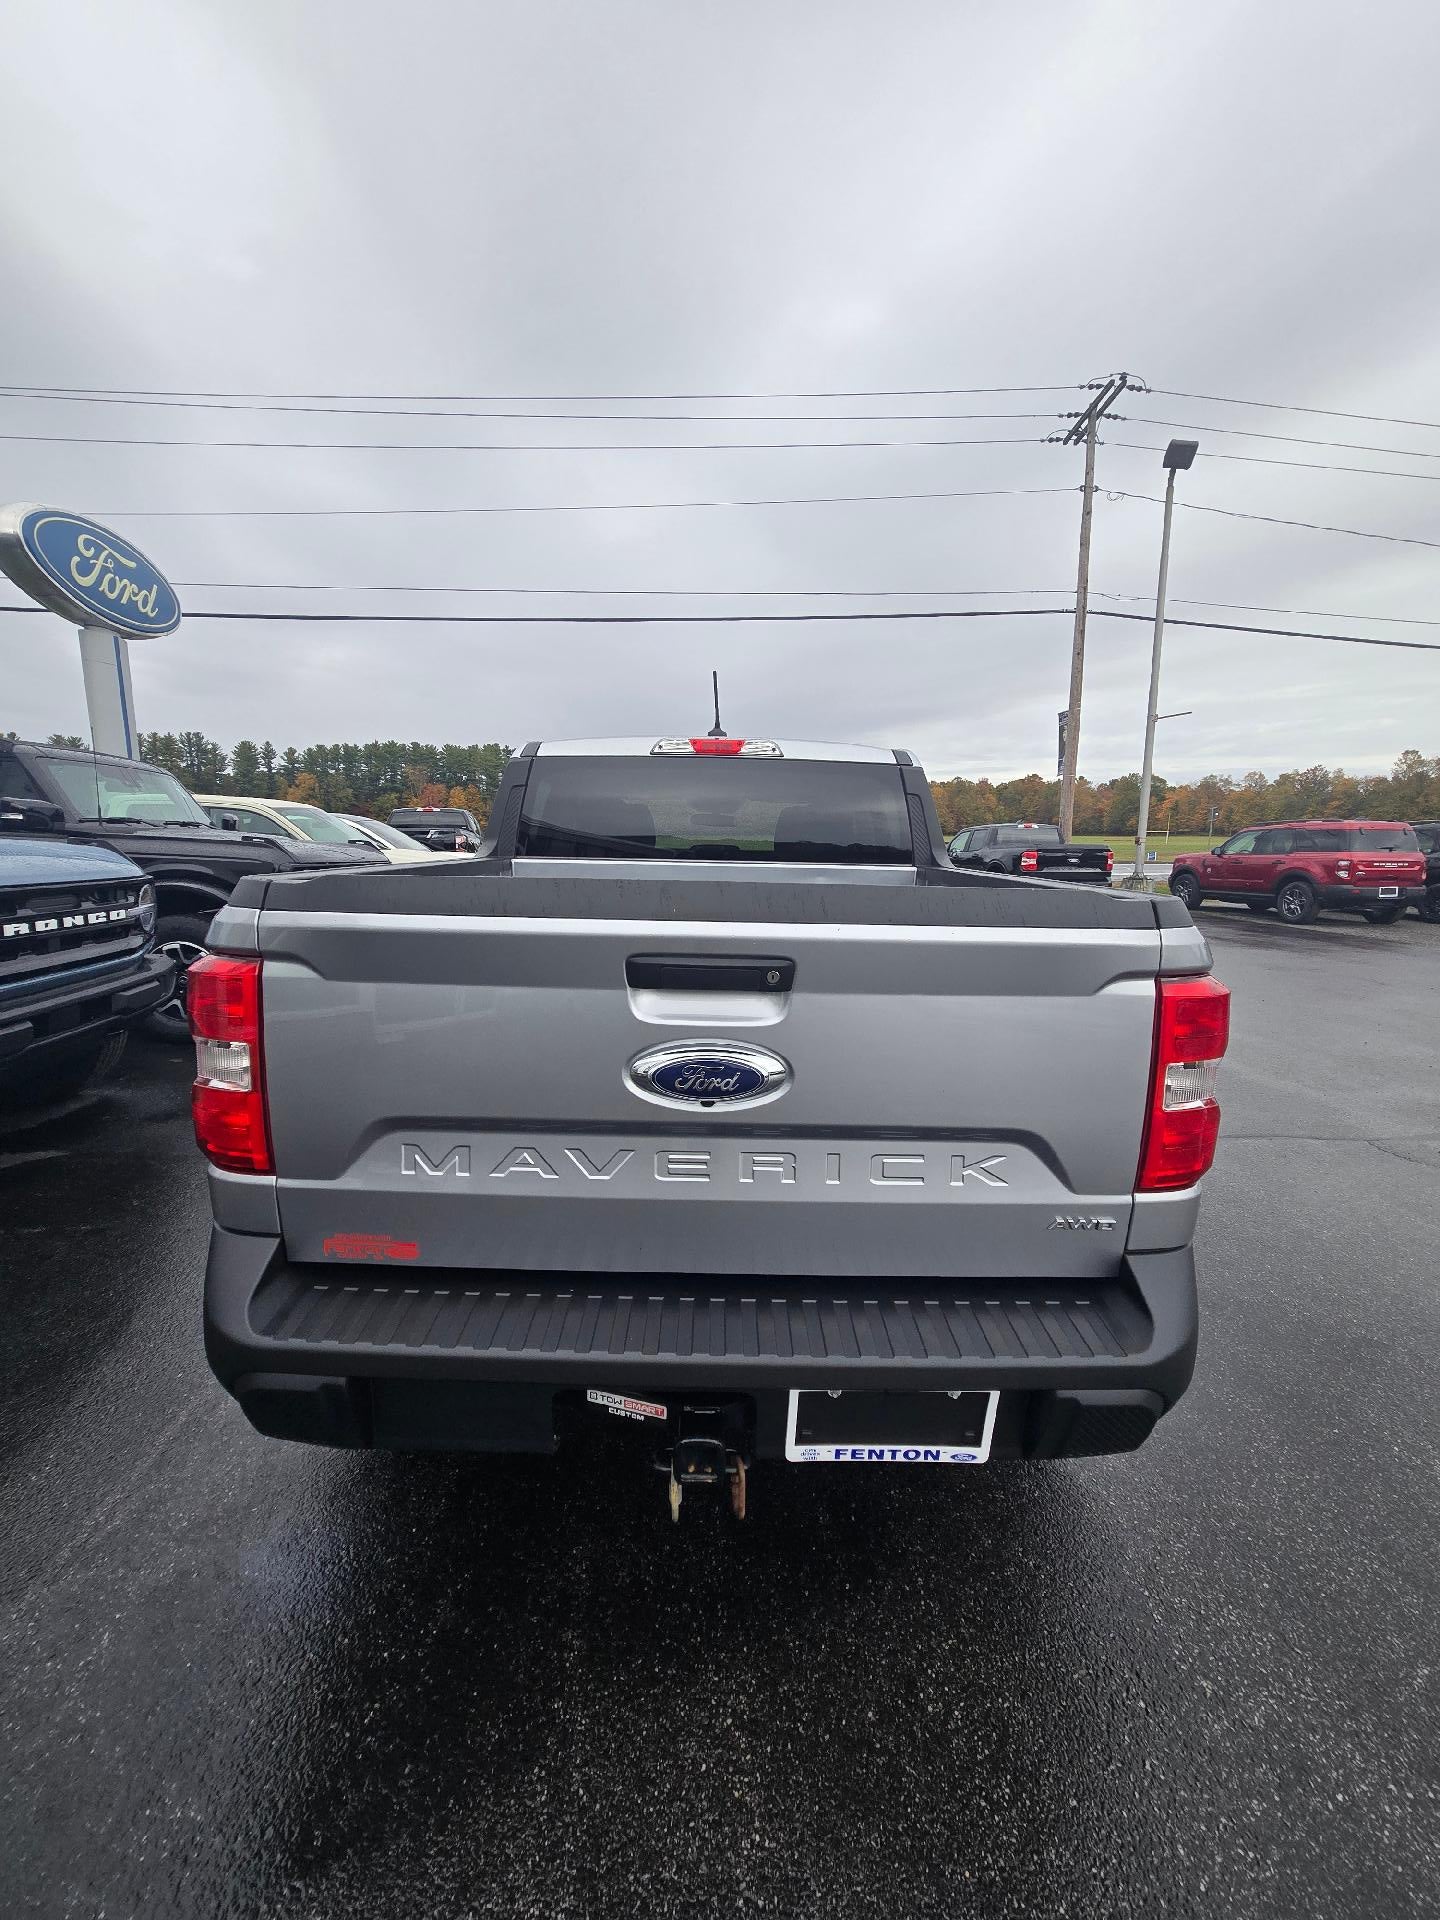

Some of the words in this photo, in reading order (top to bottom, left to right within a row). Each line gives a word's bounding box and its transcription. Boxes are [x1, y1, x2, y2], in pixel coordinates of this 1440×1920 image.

[70, 533, 159, 618] Ford
[674, 1064, 741, 1092] Ford
[400, 1143, 1009, 1187] MAVERICK
[608, 1407, 645, 1421] CUSTOM
[834, 1449, 941, 1461] FENTON
